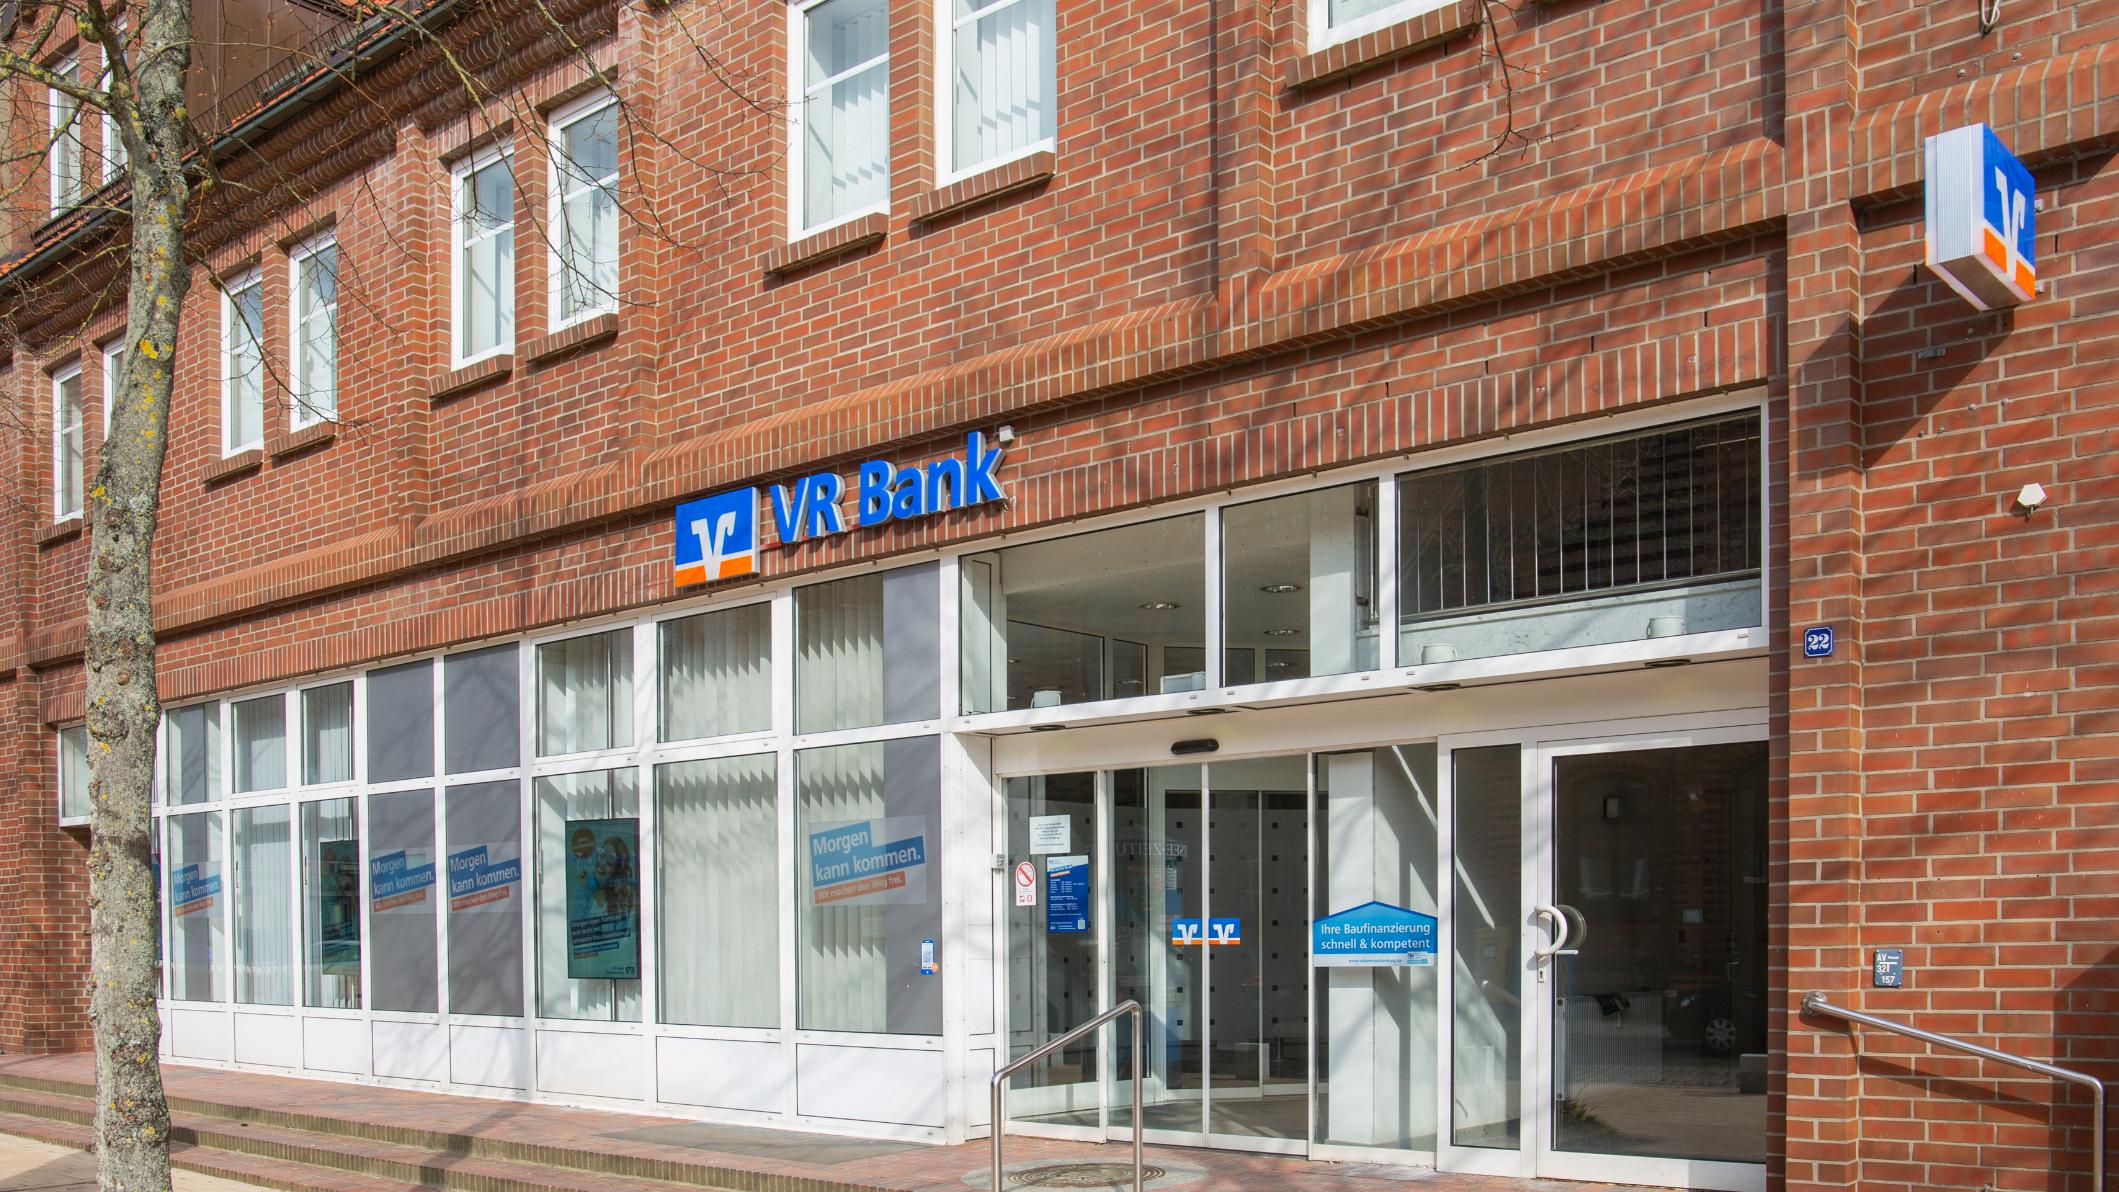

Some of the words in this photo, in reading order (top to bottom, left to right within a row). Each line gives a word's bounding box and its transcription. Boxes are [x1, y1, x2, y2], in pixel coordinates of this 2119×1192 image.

[769, 472, 846, 543] VR
[859, 431, 1006, 527] Bank
[1807, 633, 1830, 650] 22
[813, 830, 868, 856] Morgen
[372, 857, 405, 875] Morgen
[450, 853, 486, 873] Morgen
[815, 862, 850, 882] kann
[853, 846, 921, 873] kommen.
[373, 881, 395, 896] kann
[396, 870, 434, 889] kommen.
[452, 879, 474, 894] kann
[476, 866, 519, 887] kommen.
[1321, 924, 1341, 935] Ihre
[1344, 923, 1431, 936] Baufinanzierung
[1321, 939, 1356, 949] schnell
[1360, 939, 1367, 949] &
[1371, 938, 1430, 951] kompetent
[1877, 953, 1887, 962] AV
[1881, 976, 1895, 984] 157
